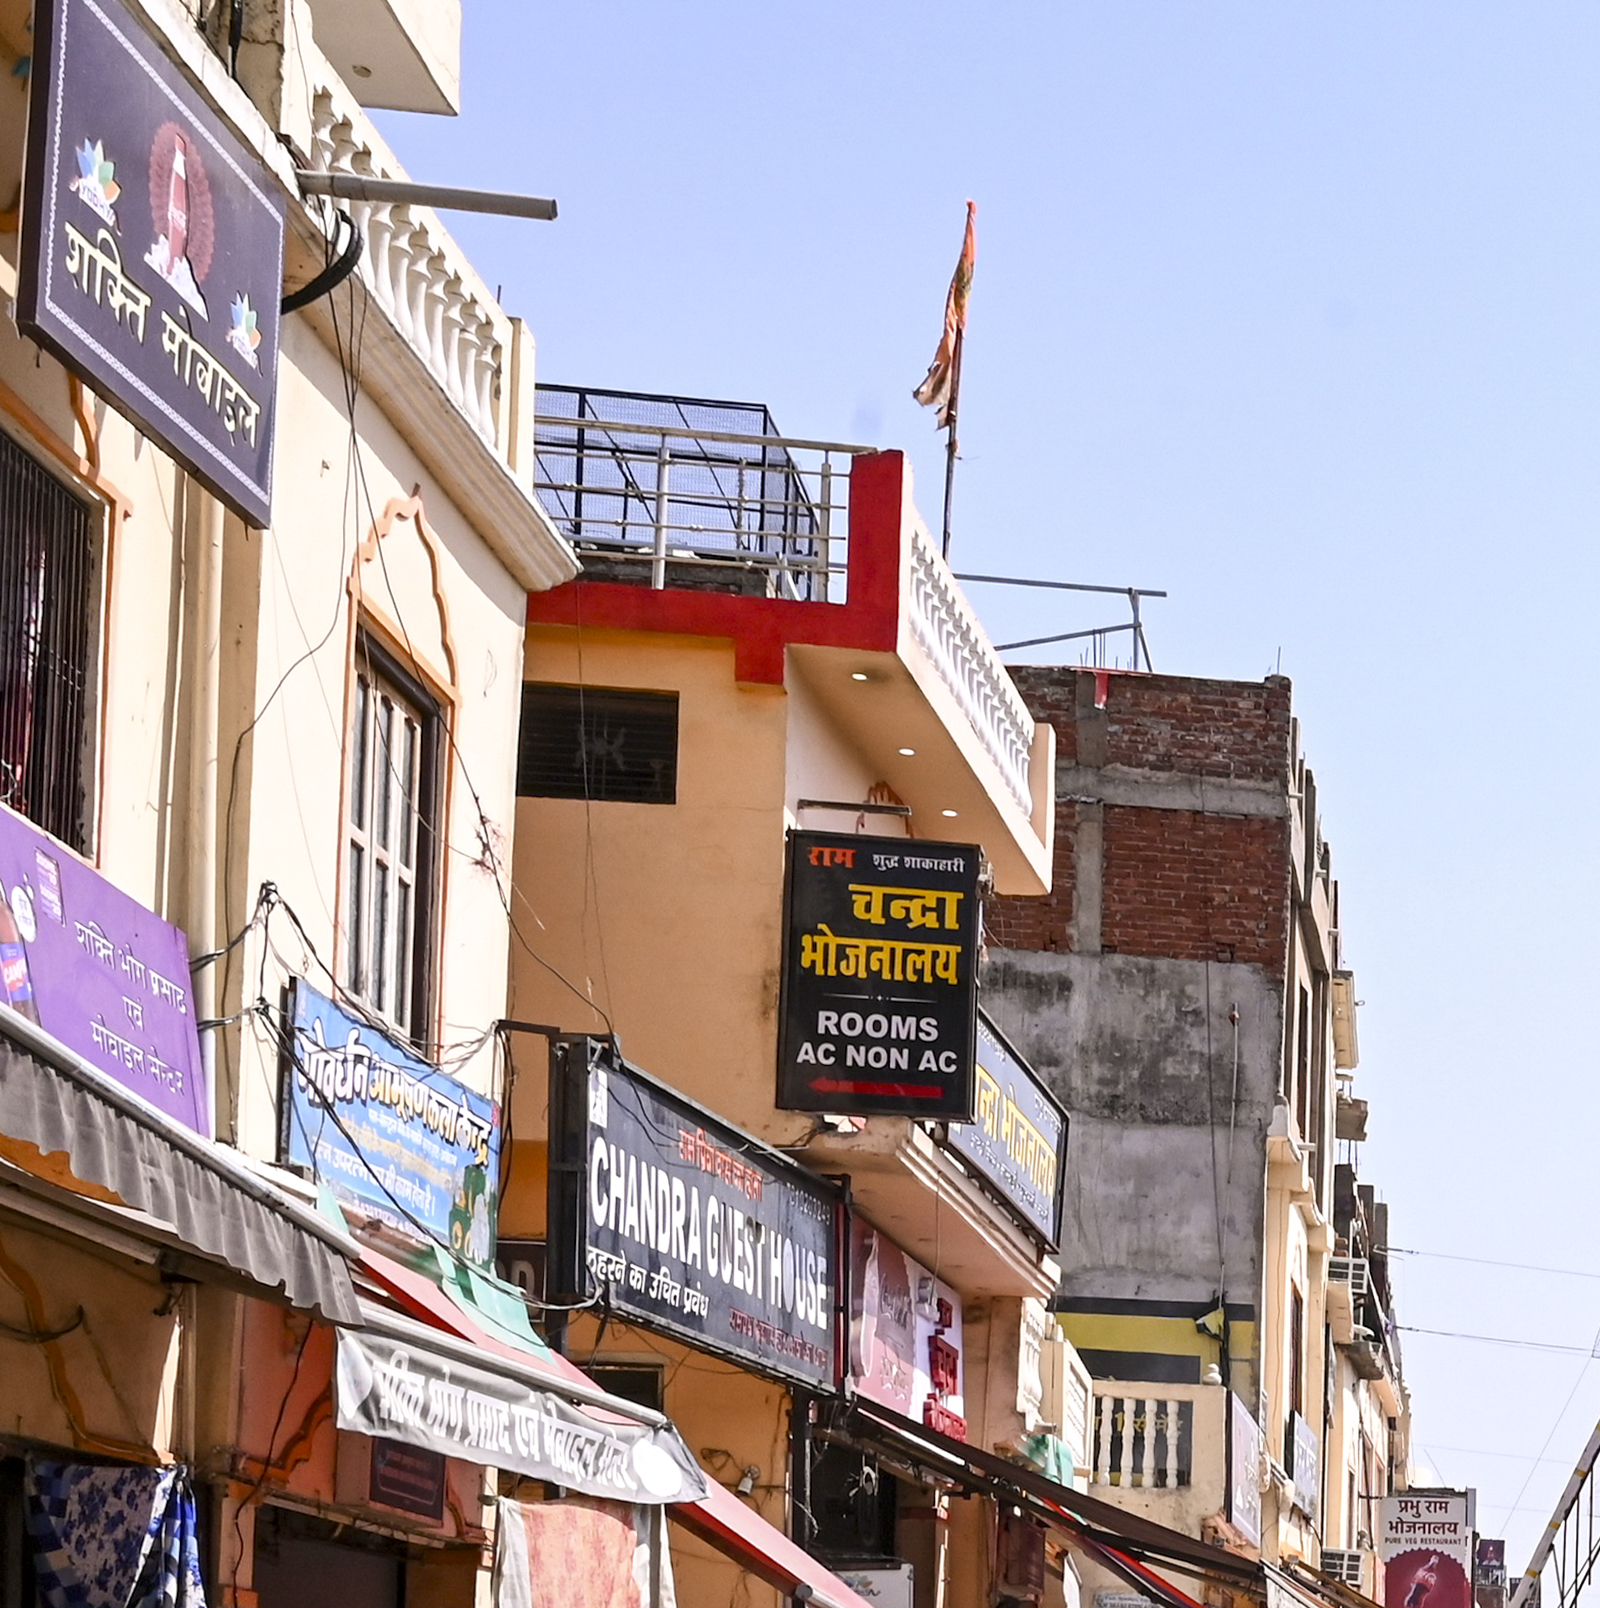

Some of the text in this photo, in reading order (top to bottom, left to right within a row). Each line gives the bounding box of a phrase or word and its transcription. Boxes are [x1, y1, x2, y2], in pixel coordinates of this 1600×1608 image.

[65, 221, 151, 344] शक्ति
[808, 846, 965, 873] राम शुद्ध शाकाहारी
[848, 884, 964, 930] चन्द्रा
[801, 923, 962, 985] भोजनालय
[817, 1010, 939, 1042] ROOMS
[796, 1041, 958, 1074] AC NON AC
[590, 1136, 701, 1269] CHANDRA
[706, 1195, 766, 1300] GUEST
[769, 1229, 827, 1330] HOUSE
[587, 1246, 627, 1286] ठहरने
[629, 1262, 647, 1294] का
[649, 1266, 682, 1308] उचित
[1398, 1500, 1450, 1518] प्रभु राम
[1388, 1517, 1459, 1535] भोजनालय
[1405, 1537, 1418, 1545] VEG
[1420, 1537, 1462, 1546] RESTAURANT
